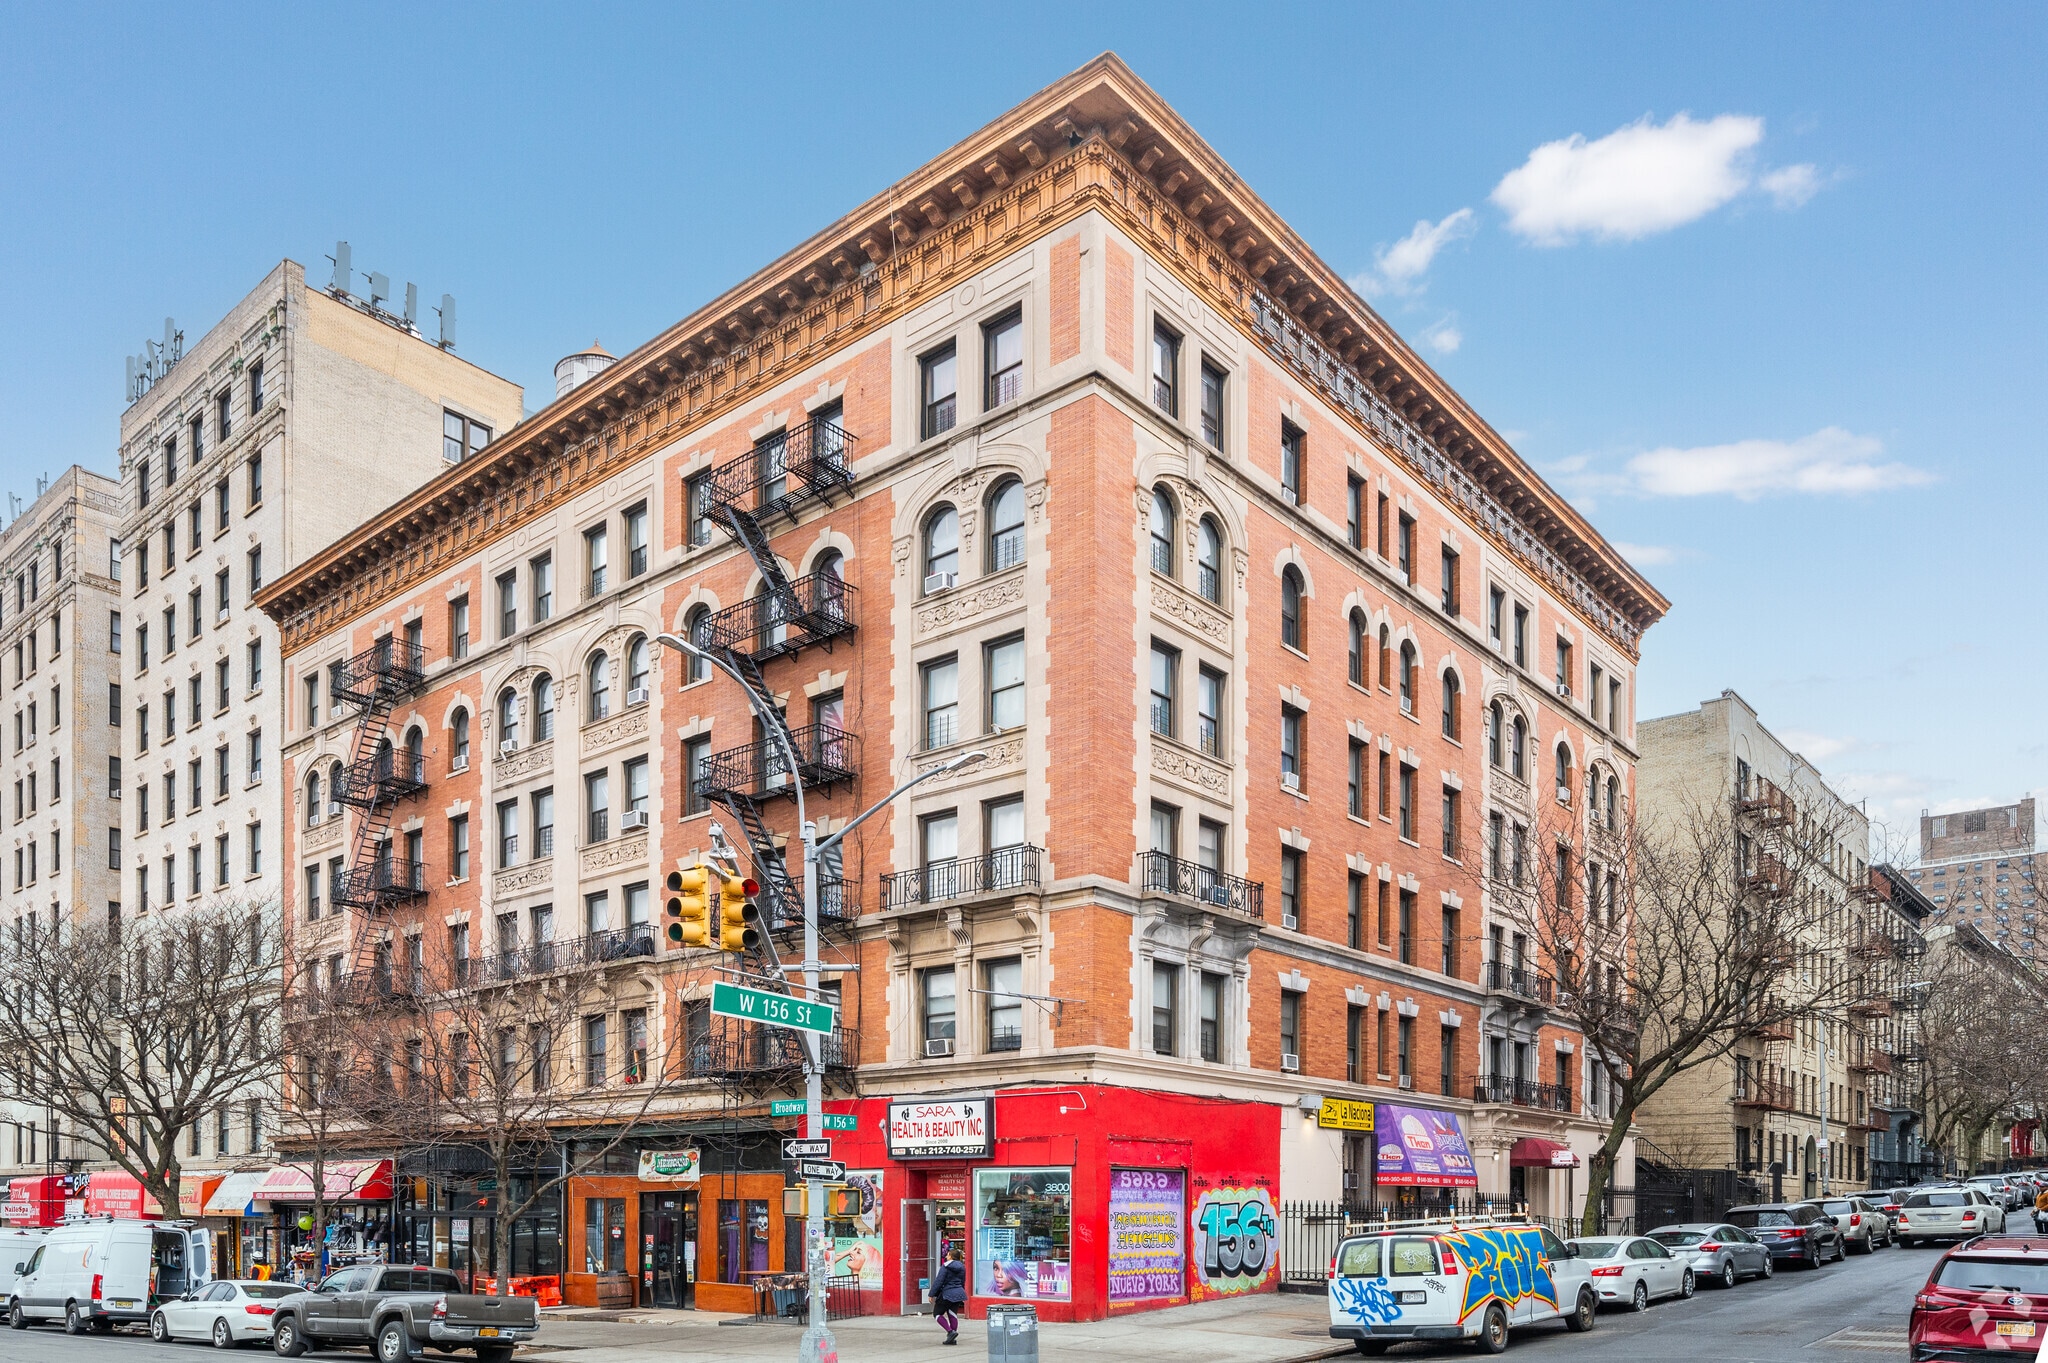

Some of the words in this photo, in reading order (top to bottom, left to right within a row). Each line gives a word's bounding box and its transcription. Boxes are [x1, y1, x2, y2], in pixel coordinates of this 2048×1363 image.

[740, 993, 755, 1012] W
[763, 999, 789, 1020] 156
[796, 1006, 811, 1025] St
[775, 1103, 804, 1114] Broadway
[916, 1105, 956, 1118] SARA
[1341, 1103, 1347, 1119] La
[1349, 1103, 1373, 1121] Nacional
[823, 1116, 831, 1127] W
[833, 1117, 847, 1128] 156
[892, 1122, 923, 1138] HEALTH
[925, 1122, 931, 1138] &
[932, 1120, 966, 1137] BEAUTY
[967, 1117, 985, 1136] INC.
[789, 1145, 804, 1153] ONE
[809, 1145, 825, 1153] WAY
[909, 1147, 927, 1155] Tel.:
[928, 1146, 985, 1155] 212-740-2577
[807, 1165, 820, 1174] ONE
[825, 1168, 839, 1176] WAY
[1045, 1183, 1070, 1192] 3800
[1117, 1229, 1176, 1249] HEIGHTS
[1149, 1258, 1174, 1268] LOVE
[1110, 1275, 1145, 1294] NUEVA
[1146, 1274, 1180, 1293] YORK
